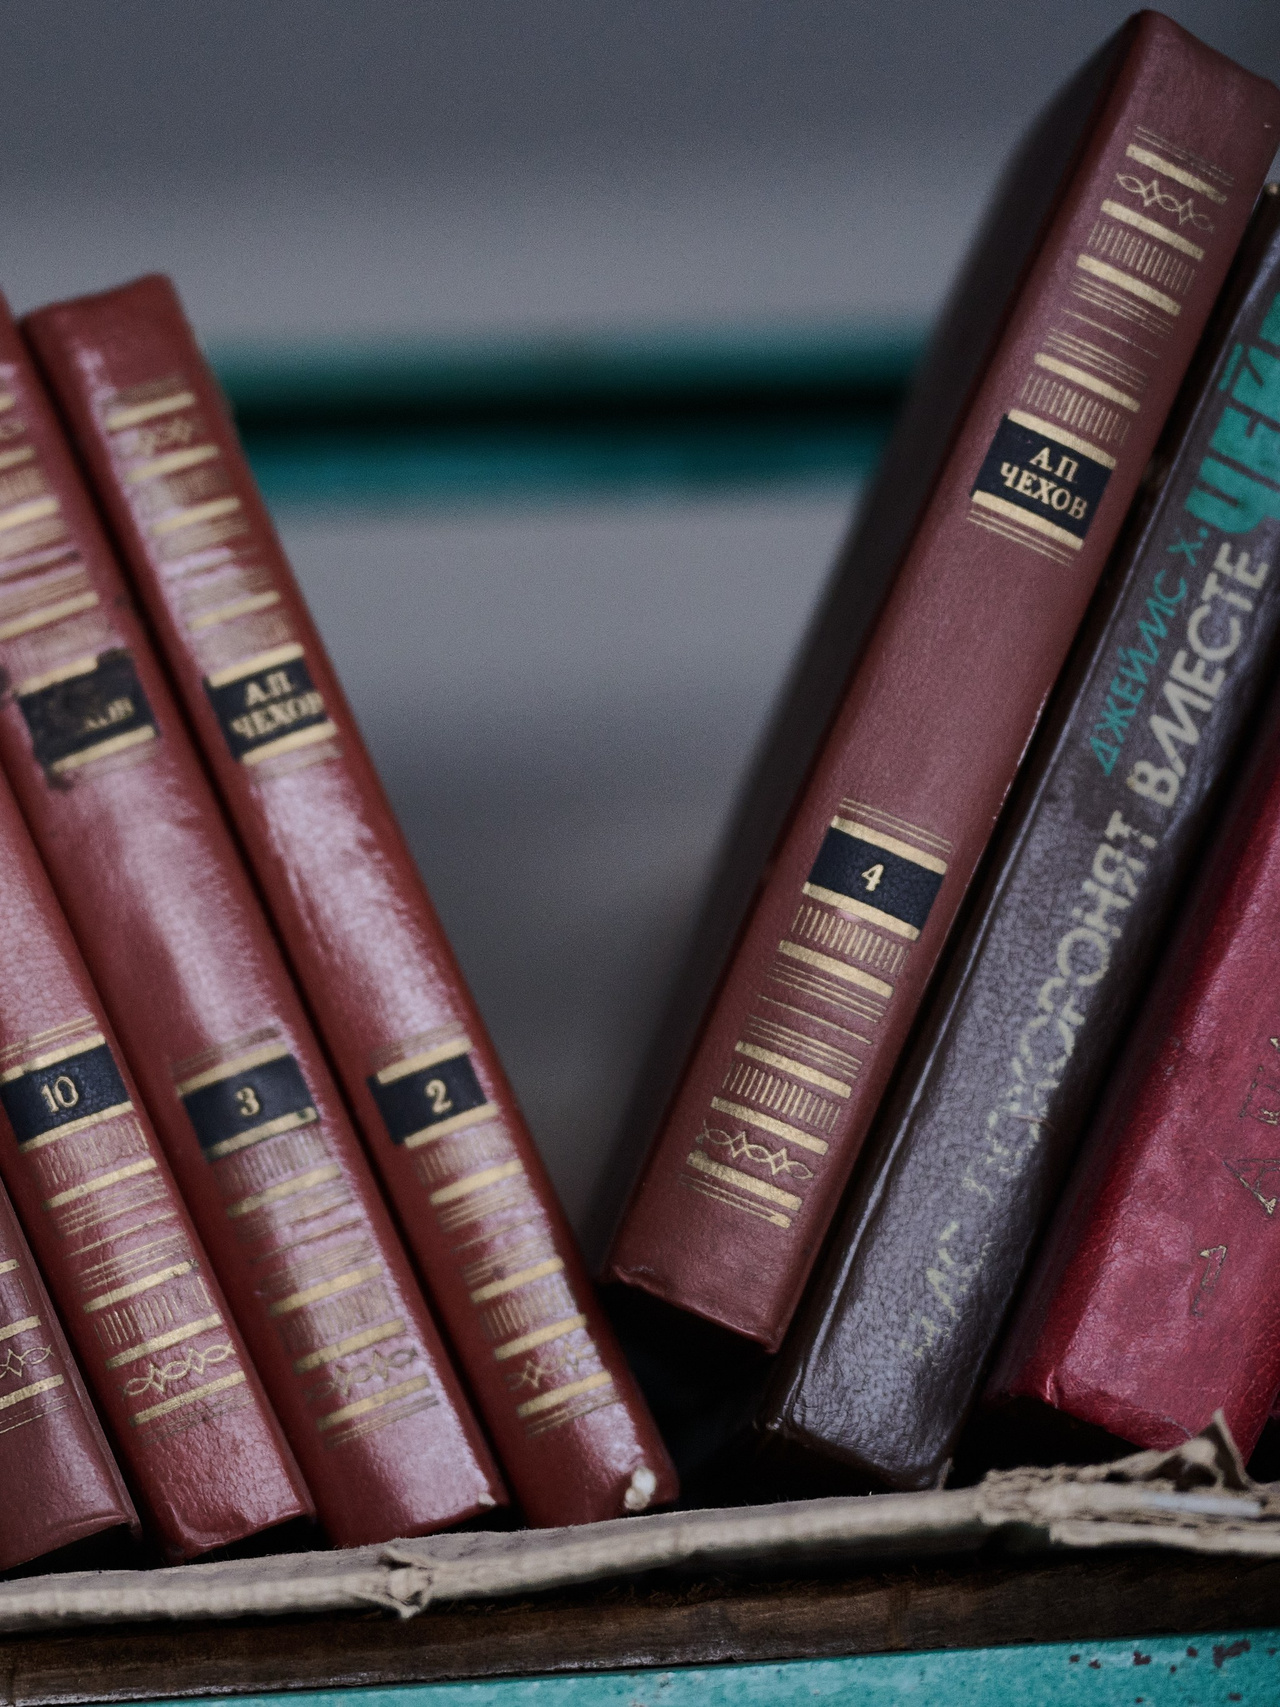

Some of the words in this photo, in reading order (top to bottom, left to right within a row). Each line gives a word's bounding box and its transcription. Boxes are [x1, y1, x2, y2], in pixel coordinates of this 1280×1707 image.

[1000, 461, 1088, 520] ЧЕХОВ
[1089, 568, 1187, 777] ДЖЕЙМС
[1168, 526, 1209, 567] Х.
[1129, 542, 1270, 808] ВМЕСТЕ
[231, 691, 324, 739] ЧЕХОВ
[861, 863, 885, 892] 4
[40, 1075, 79, 1114] 10
[236, 1087, 260, 1117] 3
[425, 1078, 452, 1115] 2
